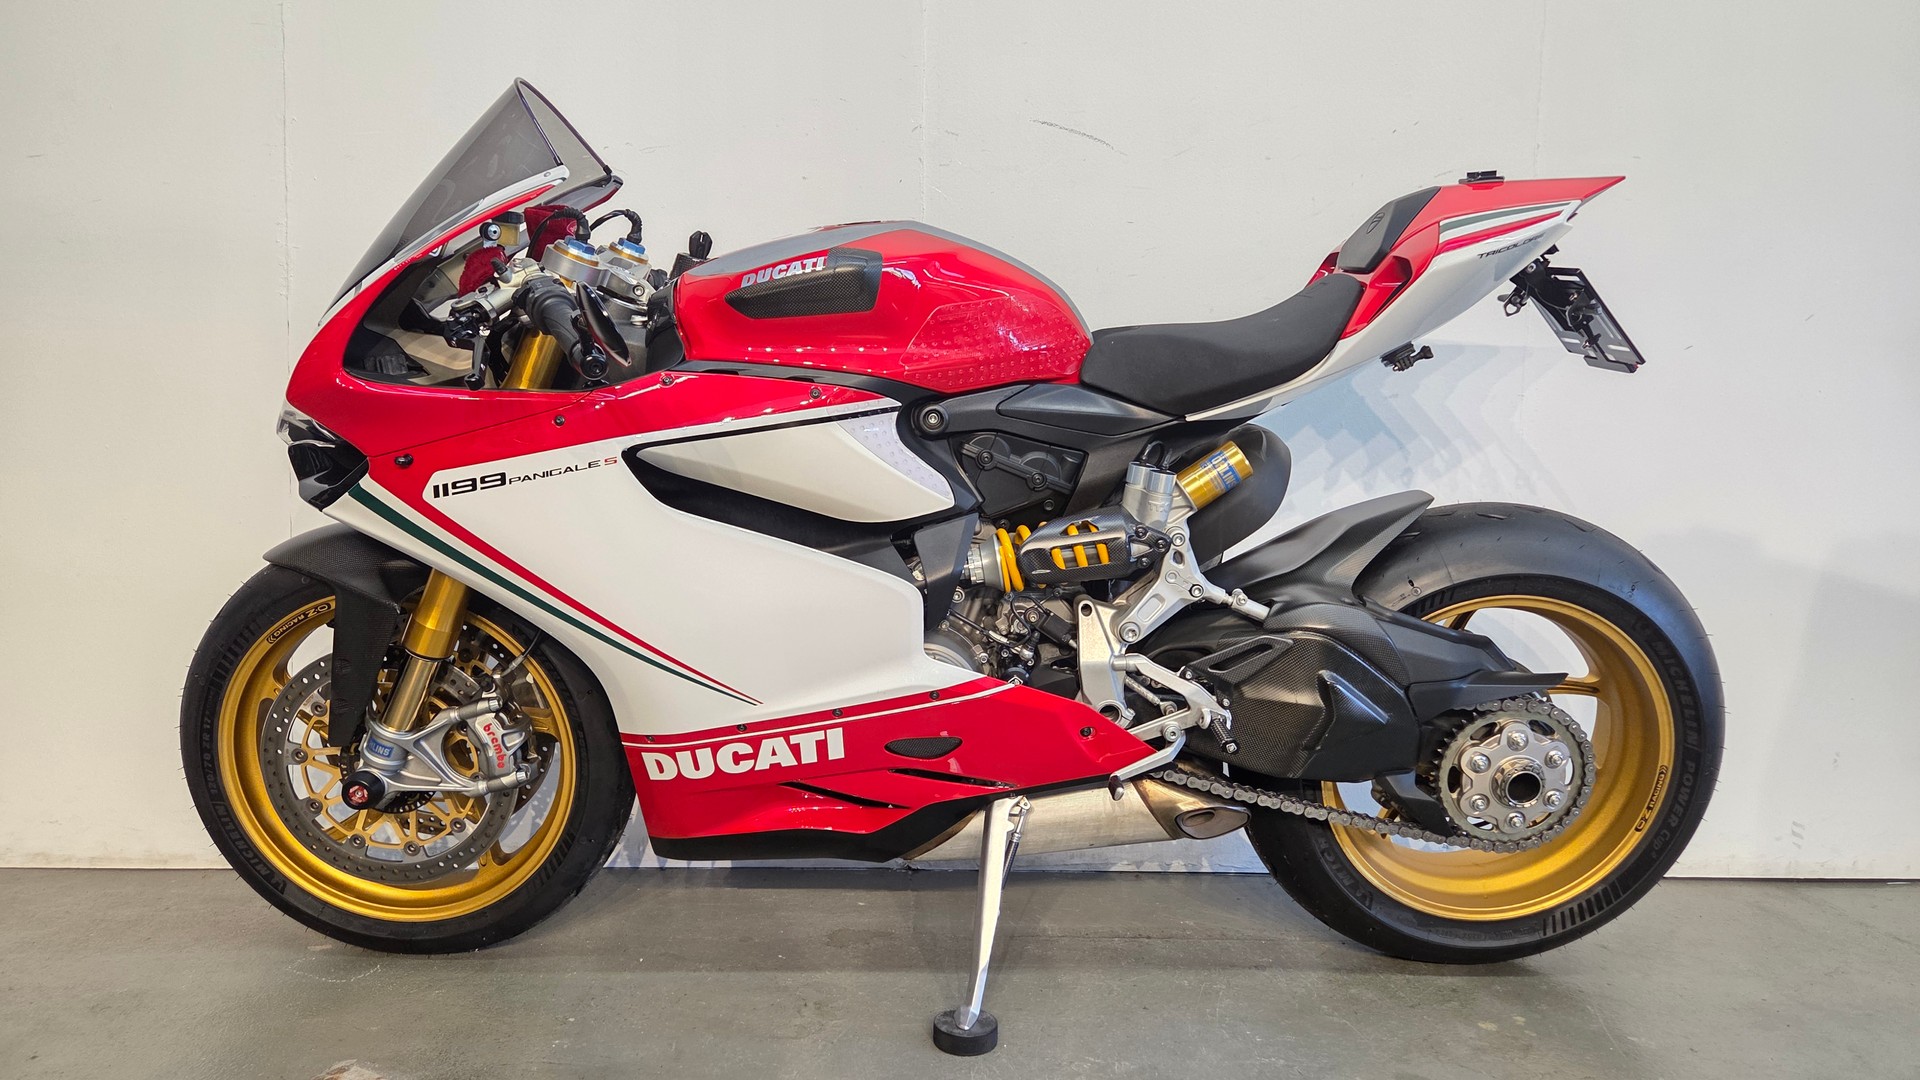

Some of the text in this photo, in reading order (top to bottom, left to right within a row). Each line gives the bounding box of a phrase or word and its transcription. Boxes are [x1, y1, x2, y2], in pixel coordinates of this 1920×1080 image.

[740, 255, 828, 288] DUCATI
[432, 456, 618, 499] 1199 PANIGALE S
[273, 614, 305, 637] RACING
[483, 722, 507, 769] brembo
[641, 727, 845, 781] DUCATI
[1668, 759, 1696, 828] POWER
[214, 804, 271, 876] MICHELIN
